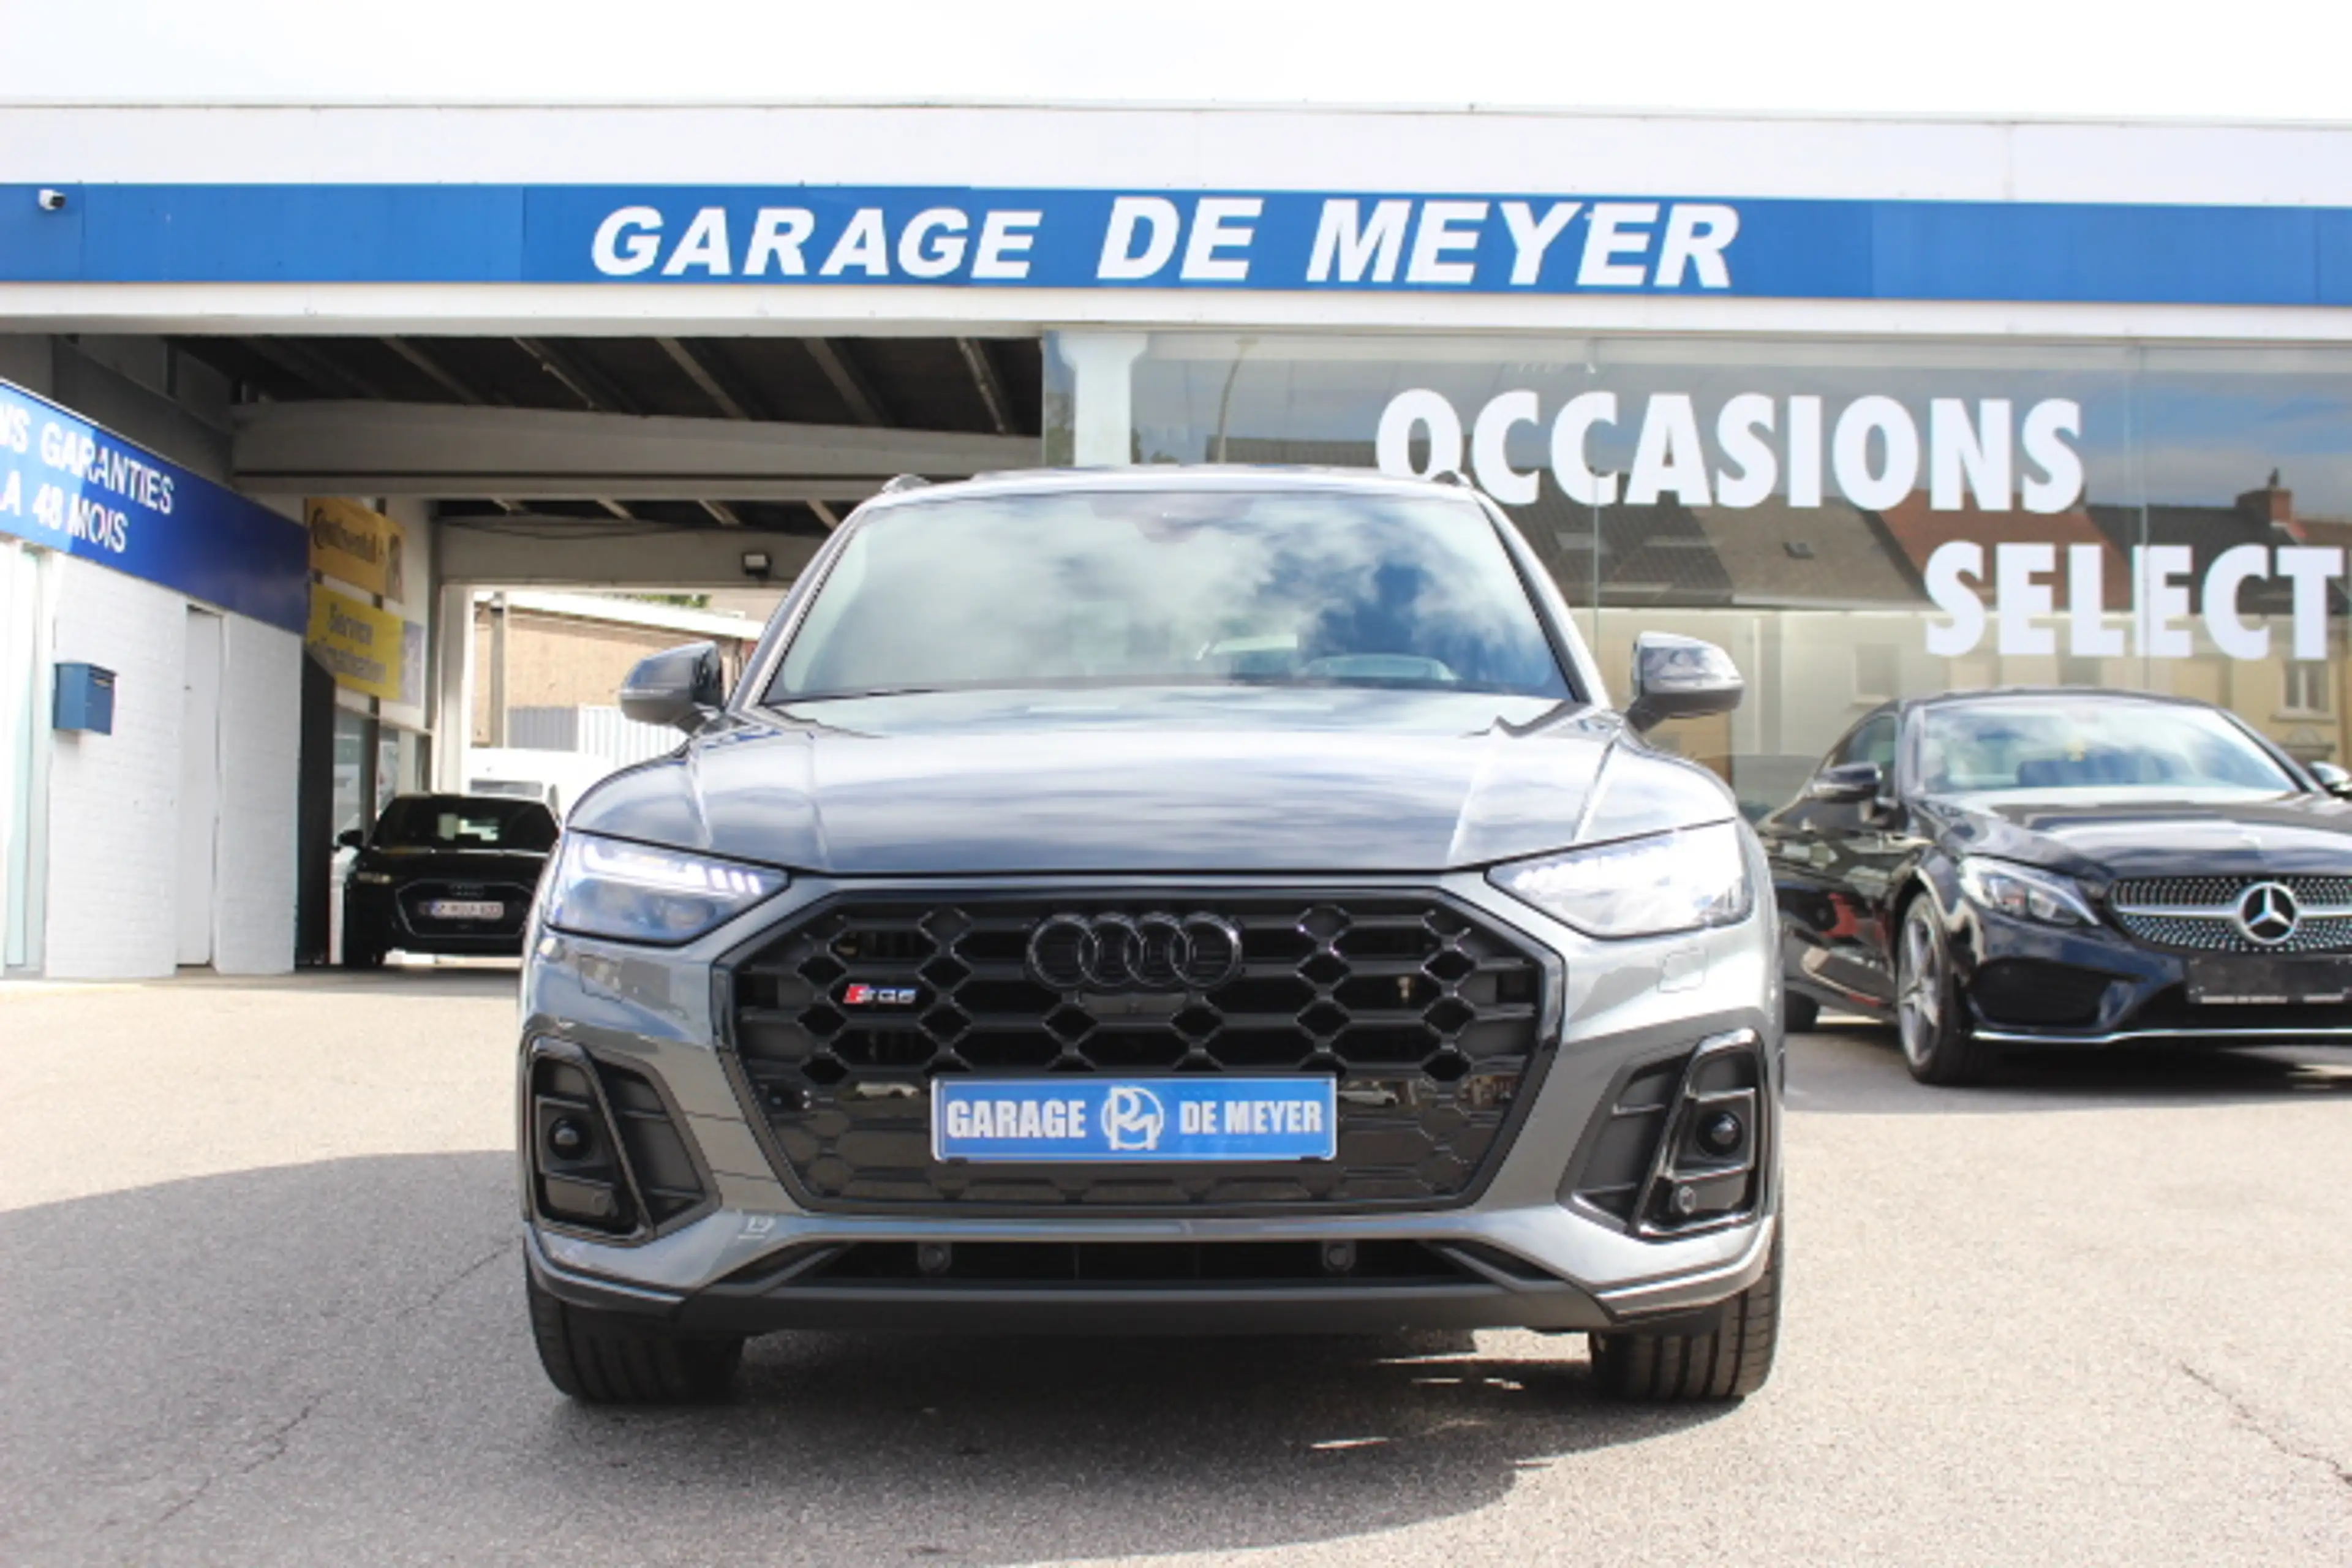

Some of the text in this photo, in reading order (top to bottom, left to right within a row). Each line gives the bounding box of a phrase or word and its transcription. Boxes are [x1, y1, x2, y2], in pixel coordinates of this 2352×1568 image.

[591, 196, 1740, 288] GARAGE DE MEYER
[40, 421, 174, 514] GARANTIES
[1376, 388, 2082, 513] OCCASIONS
[32, 483, 64, 530] 48
[67, 492, 129, 553] MOIS
[1924, 540, 2343, 660] SELECT
[946, 1100, 1086, 1138] GARAGE
[1180, 1101, 1217, 1134] DE
[1224, 1101, 1322, 1134] MEYER
